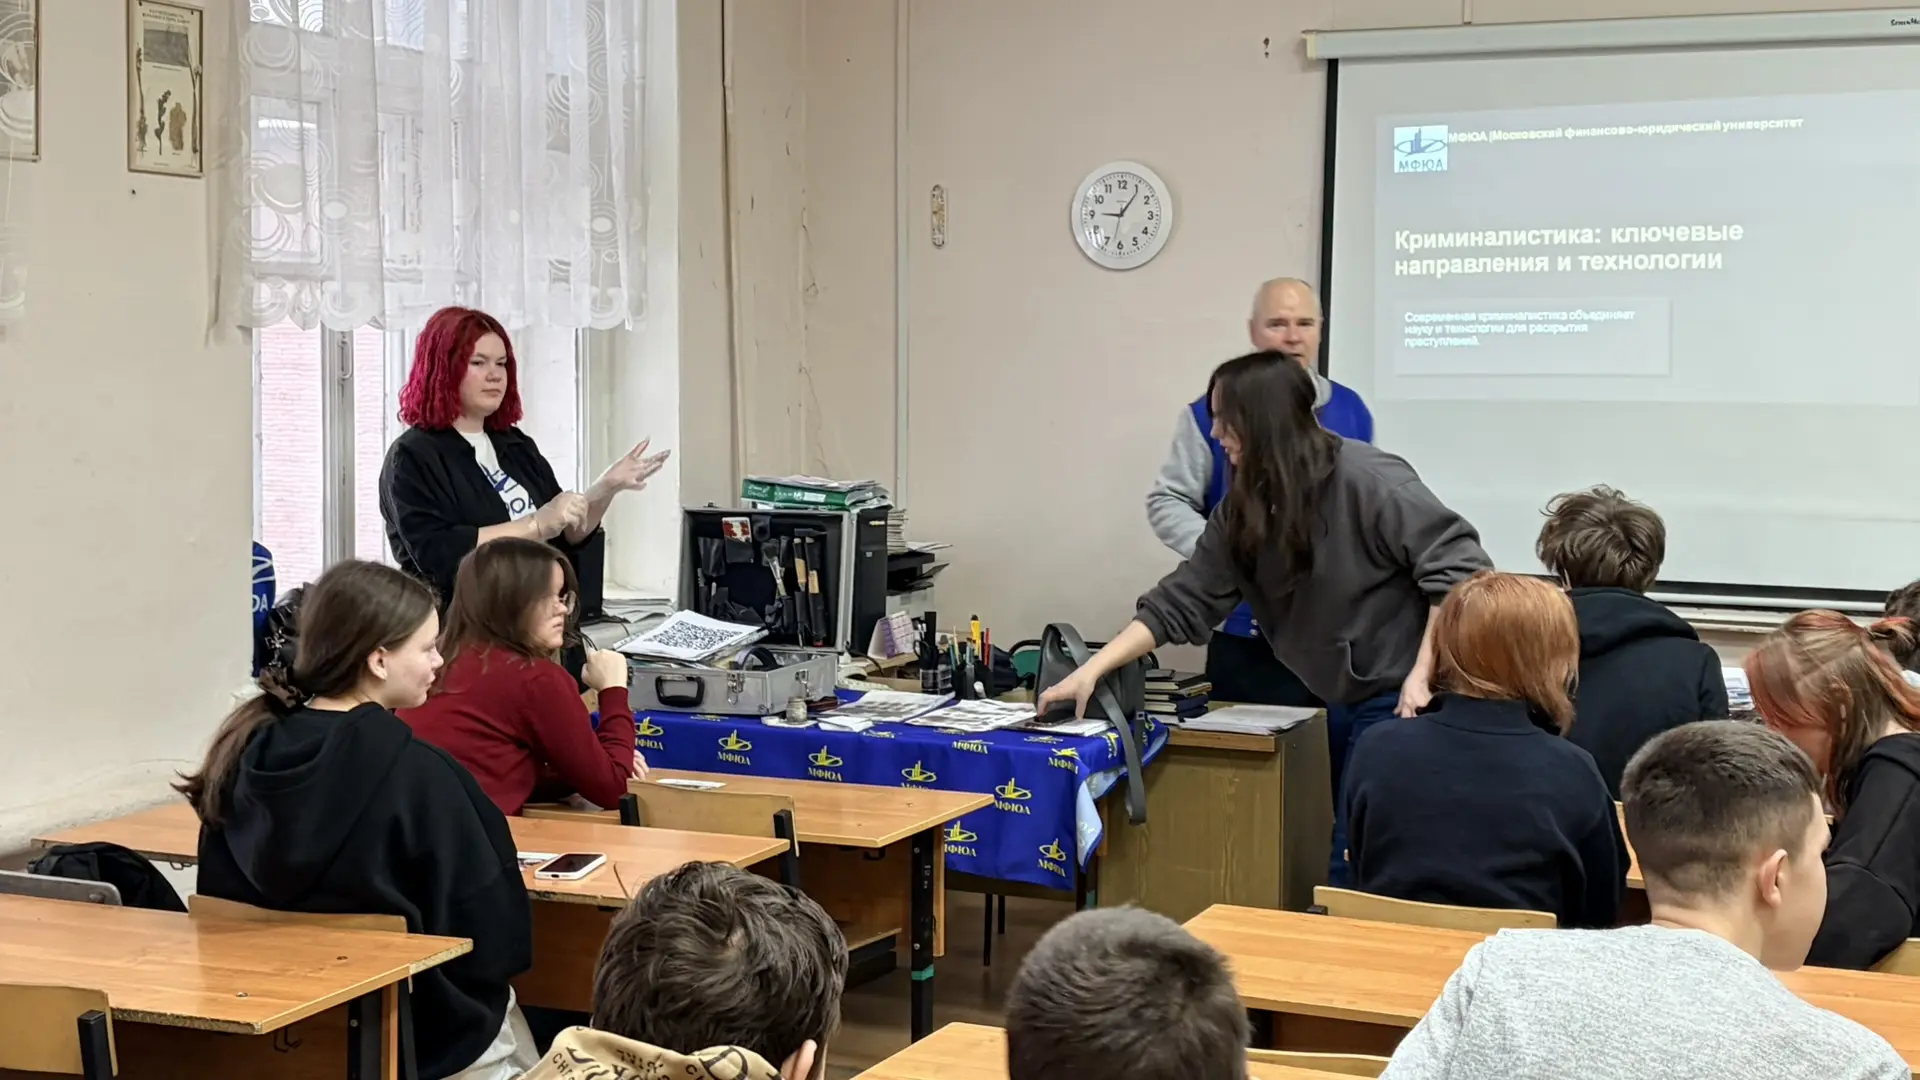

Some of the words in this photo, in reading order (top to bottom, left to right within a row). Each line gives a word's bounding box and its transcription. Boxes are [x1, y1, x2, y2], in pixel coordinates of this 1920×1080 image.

[1449, 131, 1487, 143] МФЮА
[1565, 120, 1720, 139] финансово-юридический
[1722, 118, 1804, 132] университет
[1399, 159, 1443, 172] МФЮА
[1104, 184, 1112, 193] 11
[1117, 180, 1127, 189] 12
[1095, 195, 1104, 204] 10
[1144, 195, 1150, 205] 2
[1089, 210, 1095, 219] 9
[1147, 211, 1153, 220] 3
[1142, 227, 1148, 235] 4
[1104, 237, 1110, 246] 7
[1132, 237, 1138, 246] 5
[1395, 230, 1601, 253] Криминалистика:
[1612, 223, 1744, 243] ключевые
[1117, 240, 1123, 249] 6
[1395, 254, 1549, 278] направления
[1558, 255, 1571, 271] и
[1578, 251, 1723, 270] технологии
[1405, 312, 1476, 324] Современная
[1478, 311, 1568, 323] криминалистика
[1569, 309, 1636, 321] объединяет
[1405, 324, 1432, 336] науку
[1445, 324, 1504, 335] технологии
[1506, 323, 1527, 334] для
[1529, 322, 1588, 335] раскрытия
[952, 741, 988, 754] МФЮА
[717, 751, 751, 765] МФЮА
[808, 767, 842, 781] МФЮА
